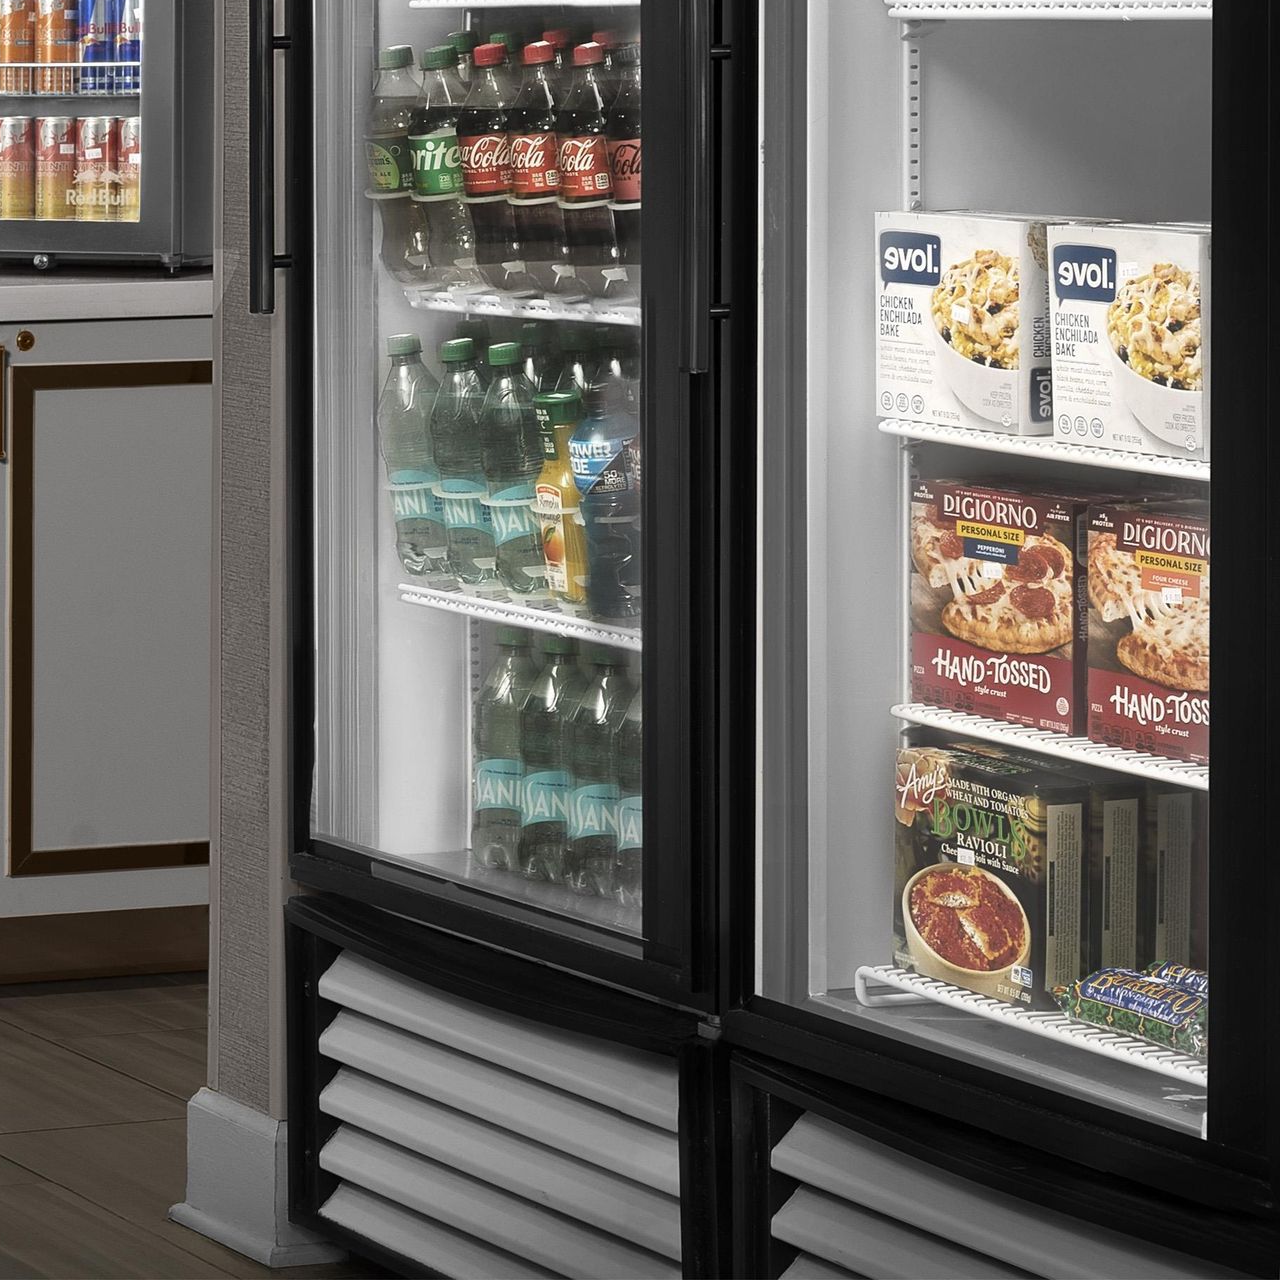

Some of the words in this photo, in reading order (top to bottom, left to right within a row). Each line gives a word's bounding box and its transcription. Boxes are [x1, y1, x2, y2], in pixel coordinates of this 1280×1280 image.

[66, 189, 95, 205] Red
[880, 295, 914, 310] CHICKEN
[880, 309, 922, 325] ENCHILADA
[880, 323, 899, 337] BAKE
[961, 525, 1000, 539] PERSONAL
[1003, 531, 1020, 542] SIZE
[931, 648, 1051, 694] HAND-TOSSED
[974, 685, 989, 695] style
[990, 688, 1007, 698] crust
[1110, 685, 1210, 725] HAND-TOSS
[896, 763, 947, 808] Amy's
[948, 777, 970, 790] MADE
[971, 783, 990, 795] WITH
[991, 788, 1025, 807] ORGANIC
[946, 789, 973, 806] WHEAT
[974, 796, 989, 809] AND
[990, 801, 1029, 820] TOMATOES
[930, 798, 1026, 860] BOWLS
[957, 832, 1007, 859] RAVIOLI
